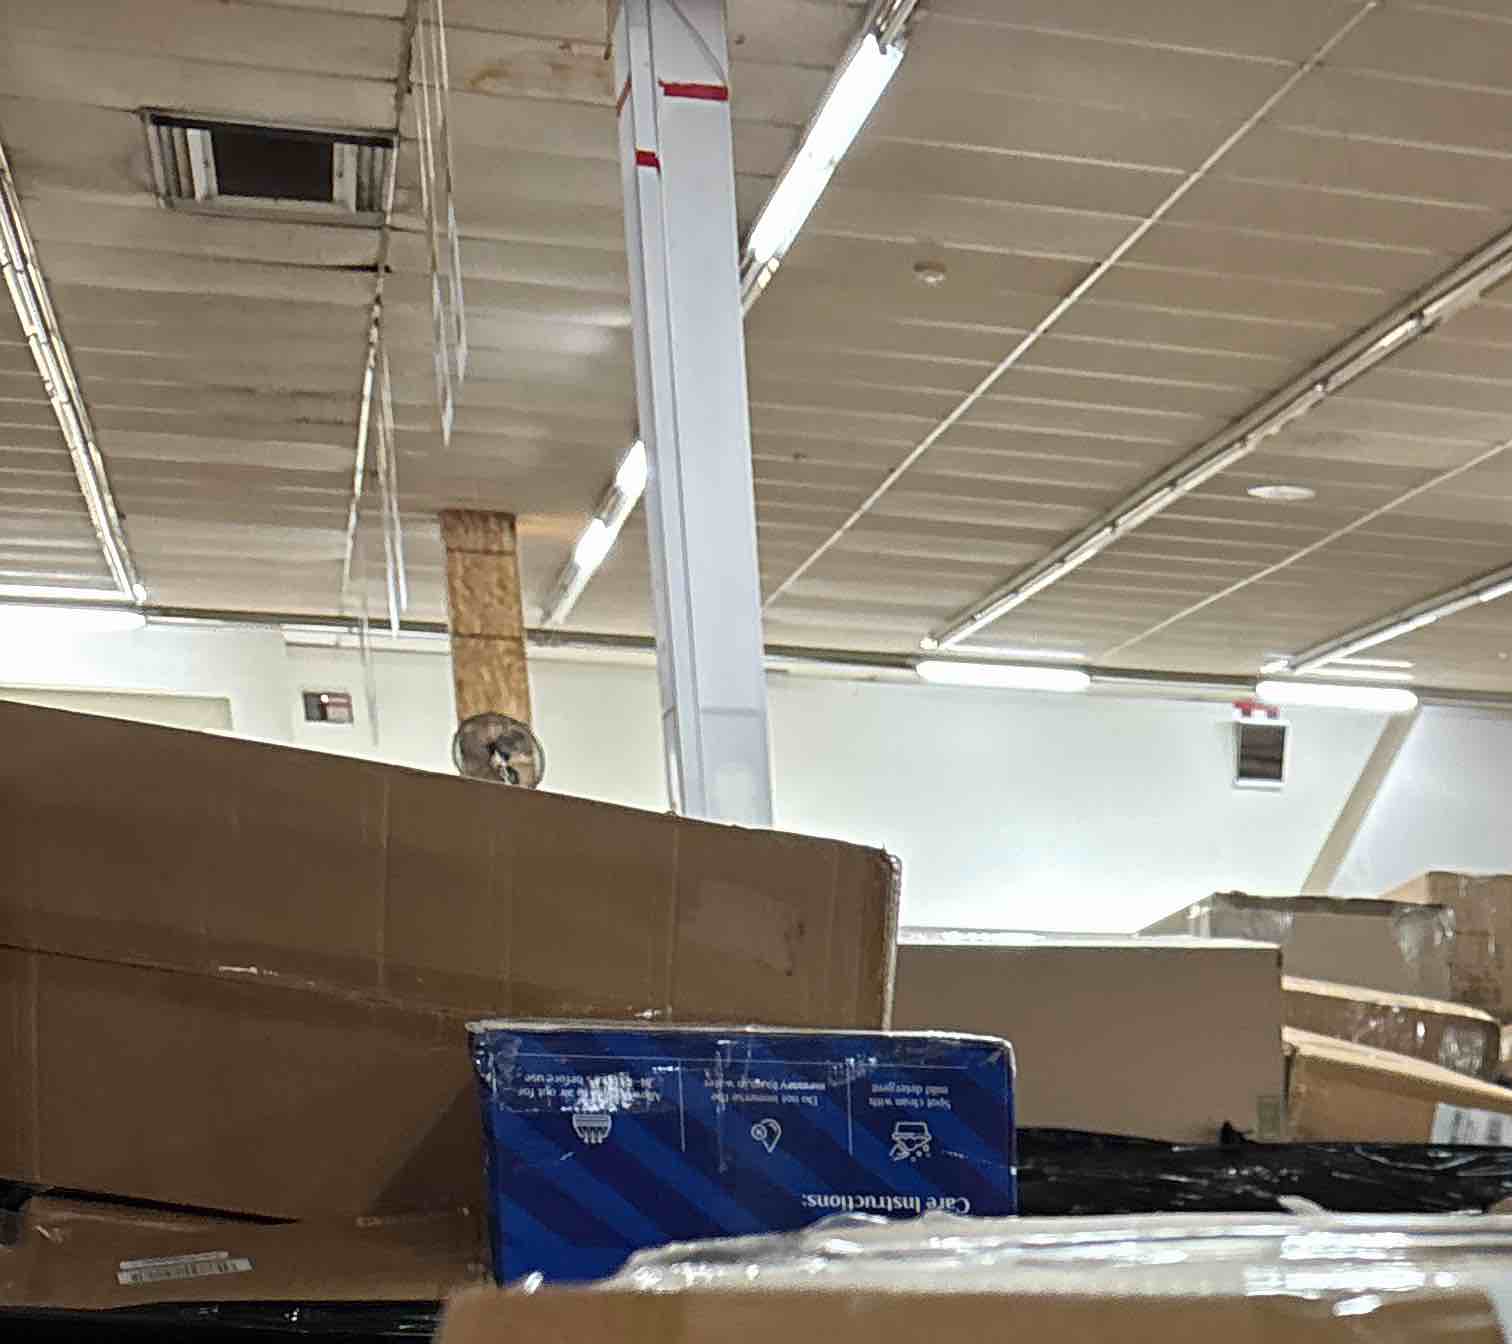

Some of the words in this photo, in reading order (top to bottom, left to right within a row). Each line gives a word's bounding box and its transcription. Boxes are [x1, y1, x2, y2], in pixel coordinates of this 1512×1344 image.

[872, 1081, 923, 1096] detergent
[801, 1193, 921, 1214] Instructions:
[926, 1196, 970, 1214] Care
